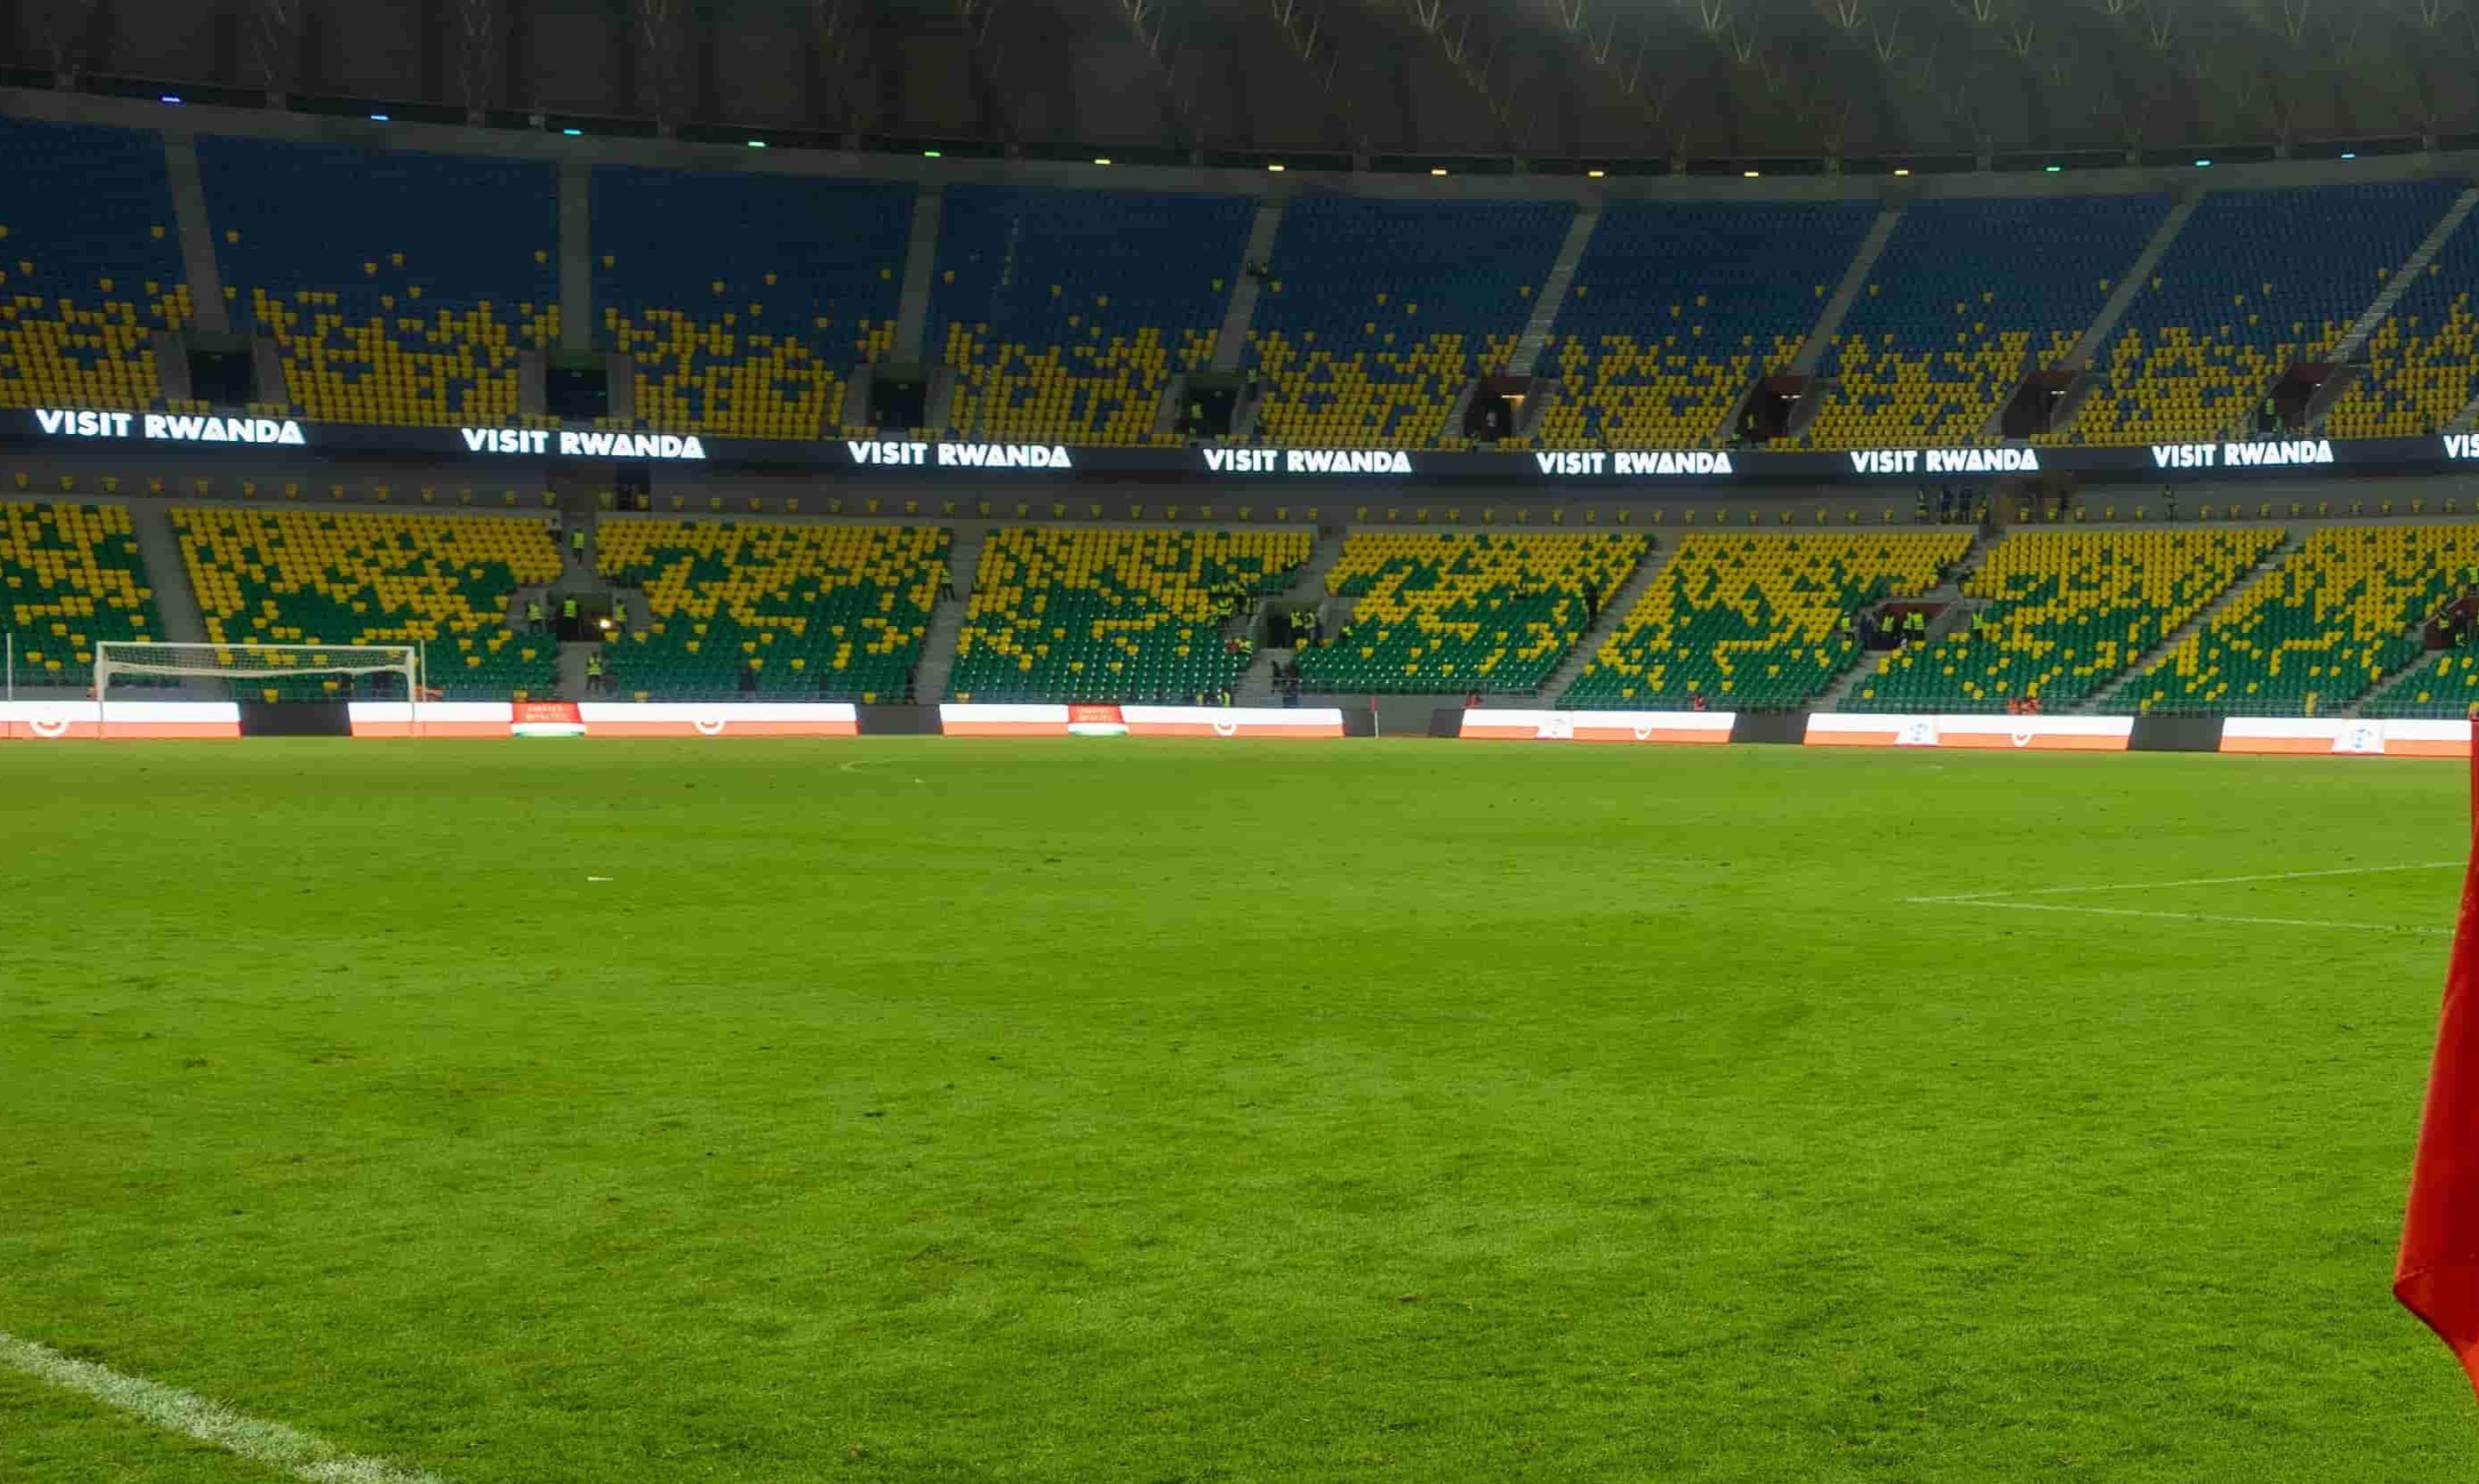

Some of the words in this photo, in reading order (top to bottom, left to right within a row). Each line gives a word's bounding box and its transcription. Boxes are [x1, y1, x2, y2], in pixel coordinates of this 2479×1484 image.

[35, 408, 133, 437] VISIT
[144, 413, 306, 445] RWANDA
[461, 427, 550, 454] VISIT
[559, 430, 707, 460] RWANDA
[846, 440, 928, 465] VISIT
[937, 443, 1072, 469] RWANDA
[2151, 443, 2218, 468] VISIT
[2224, 439, 2335, 466] RWANDA
[1202, 448, 1279, 472] VISIT
[1287, 449, 1413, 473] RWANDA
[1535, 451, 1607, 475] VISIT
[1614, 451, 1733, 475] RWANDA
[1849, 447, 1919, 473] VISIT
[1925, 447, 2039, 473] RWANDA
